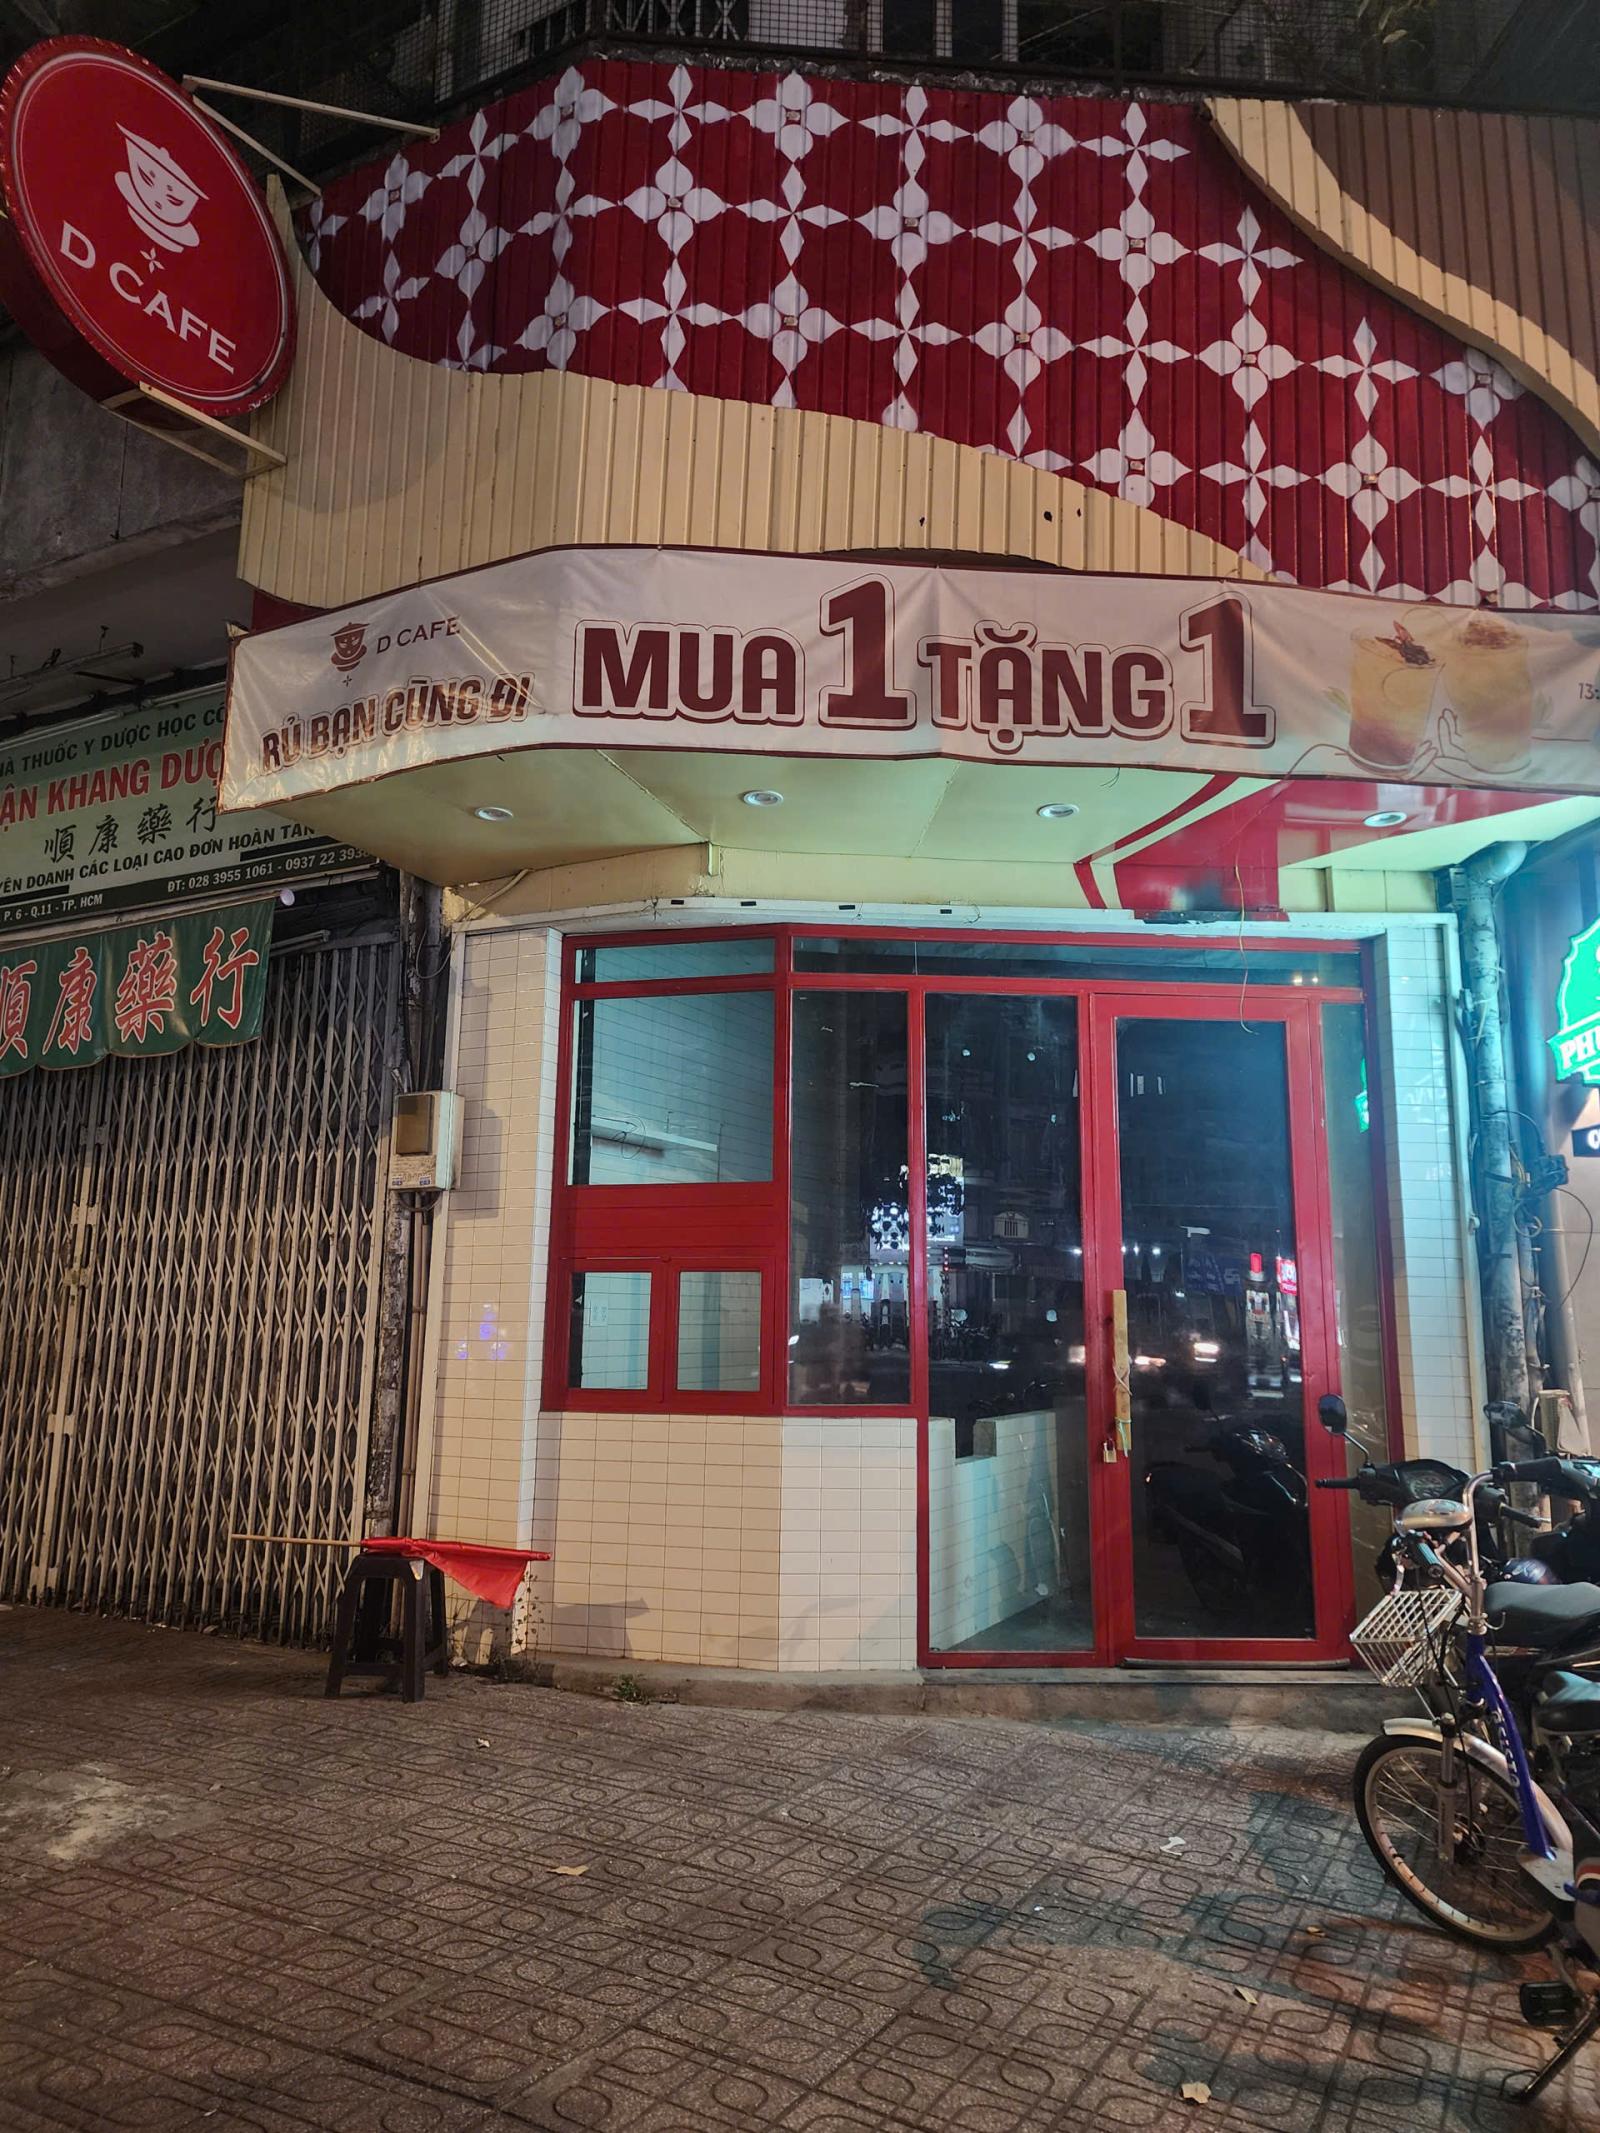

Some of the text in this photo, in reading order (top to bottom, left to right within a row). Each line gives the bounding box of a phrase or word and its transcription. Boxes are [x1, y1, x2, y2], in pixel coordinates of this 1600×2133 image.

[60, 220, 236, 375] D CAFE
[376, 615, 461, 654] D CAFE
[577, 578, 1274, 752] MUA 1 TẶNG 1
[22, 739, 78, 772] THUỐC
[84, 738, 94, 755] Y
[101, 724, 151, 752] DƯỢC
[157, 713, 196, 739] HỌC
[261, 717, 301, 776] RỦ
[309, 697, 377, 756] BẠN
[489, 676, 531, 717] ĐI
[47, 758, 150, 816] KHANG
[27, 867, 75, 889] DOANH
[79, 859, 109, 879] CÁC
[114, 852, 148, 872] LOẠI
[154, 846, 184, 865] CAO
[190, 838, 224, 858] ĐƠN
[228, 825, 275, 850] HOÀN
[44, 795, 217, 863] 順康藥行
[188, 873, 210, 889] 028
[212, 868, 241, 886] 3955
[246, 862, 274, 880] 1061
[285, 855, 316, 872] 0937
[319, 852, 335, 866] 22
[4, 910, 13, 922] P.
[15, 909, 22, 919] 6
[31, 904, 52, 918] Q.11
[62, 899, 77, 911] TP.
[80, 893, 103, 907] HCM
